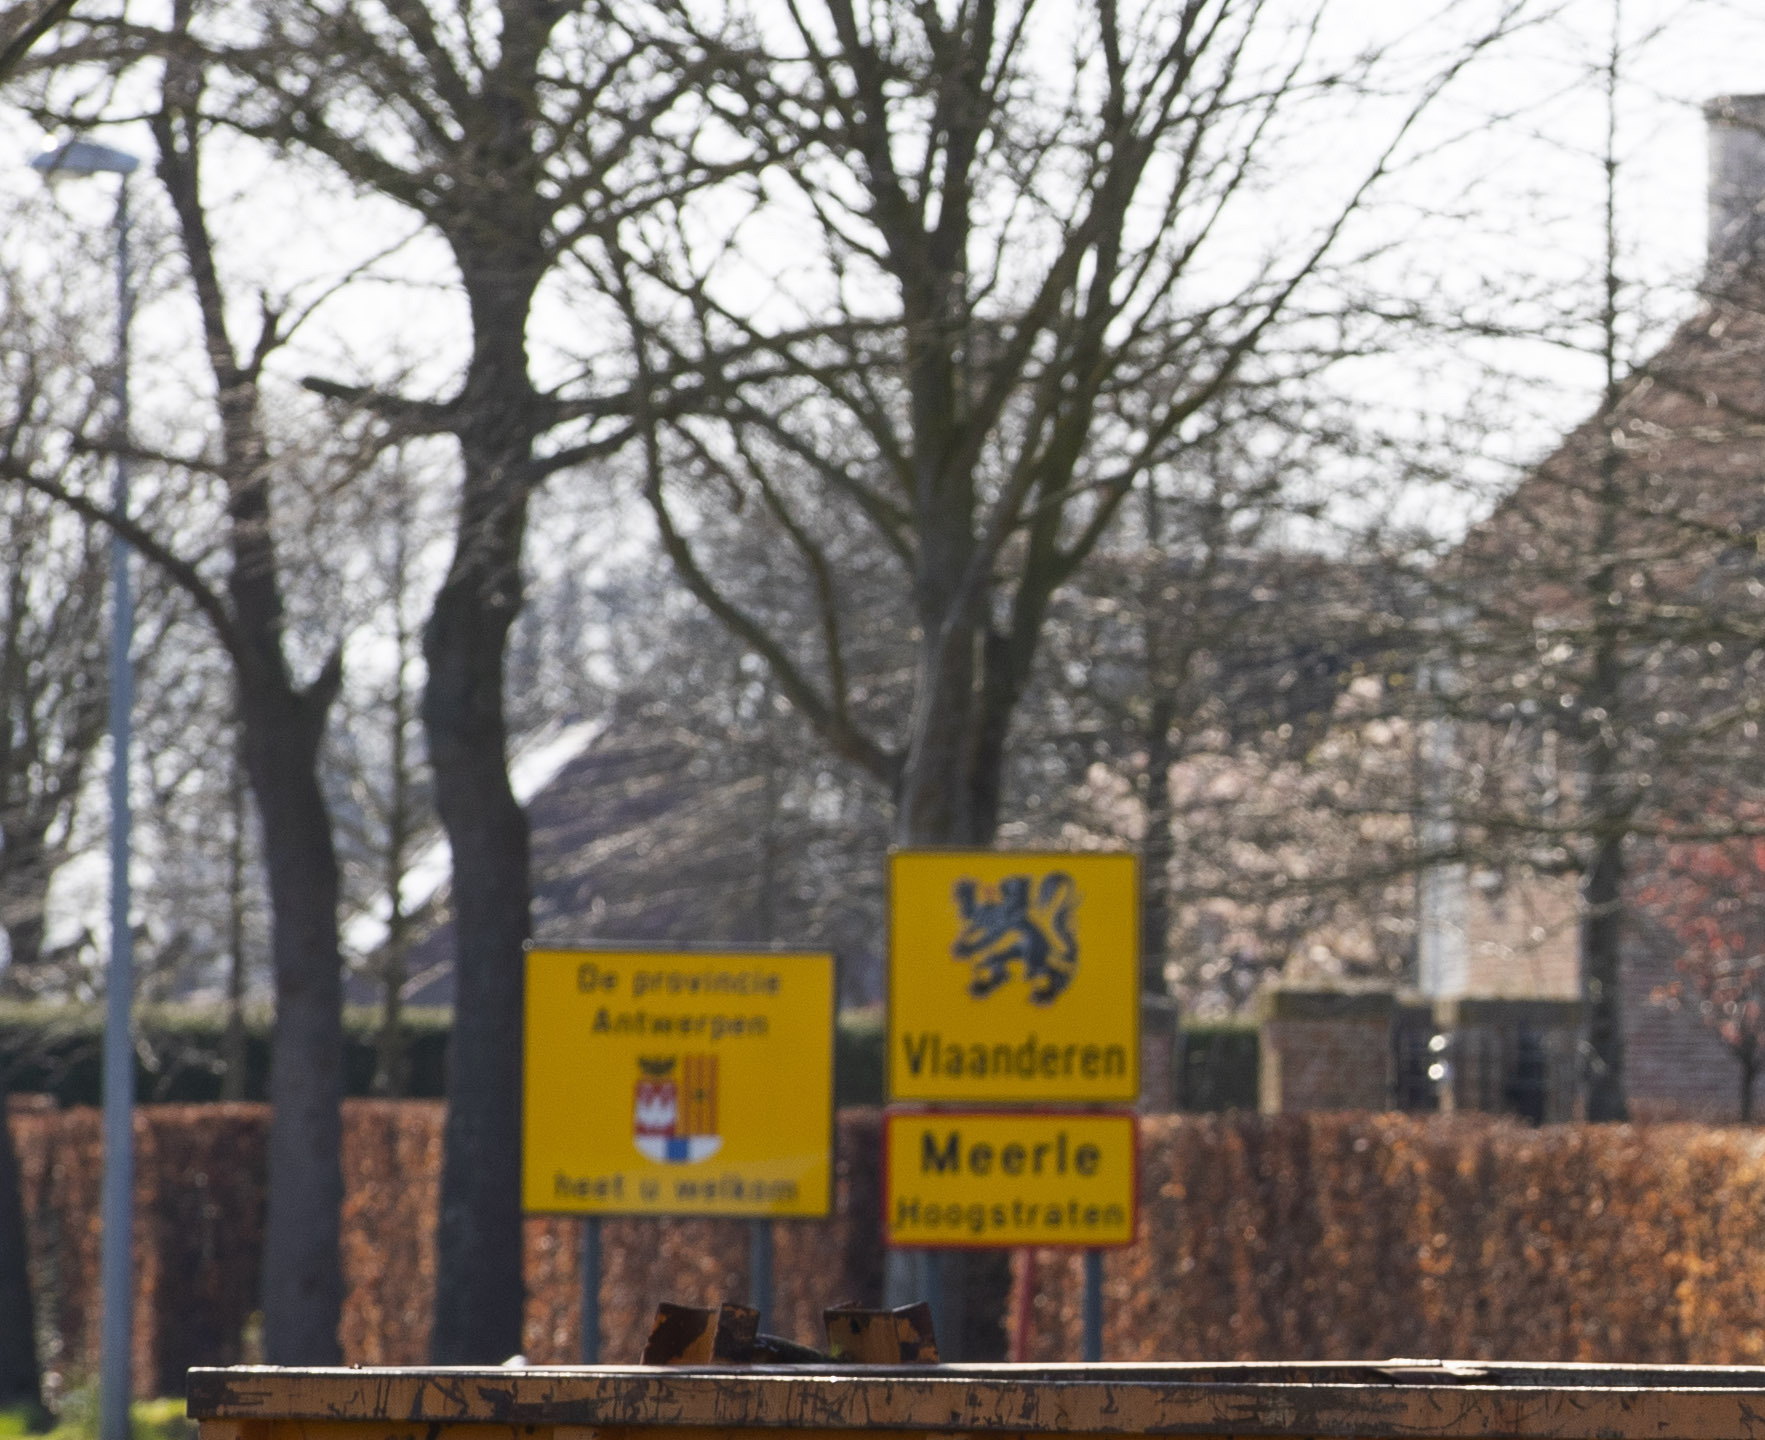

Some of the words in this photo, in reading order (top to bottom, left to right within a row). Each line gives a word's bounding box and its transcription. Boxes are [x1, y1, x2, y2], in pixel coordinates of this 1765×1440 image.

[577, 963, 618, 994] De
[633, 970, 782, 998] provincie
[592, 1008, 770, 1040] Antwerpen
[903, 1034, 1126, 1079] Vlaanderen
[921, 1131, 1102, 1177] Meerle
[554, 1172, 624, 1200] heet
[639, 1179, 661, 1202] u
[676, 1172, 798, 1203] welkom
[892, 1196, 1126, 1234] Hoogstraten
